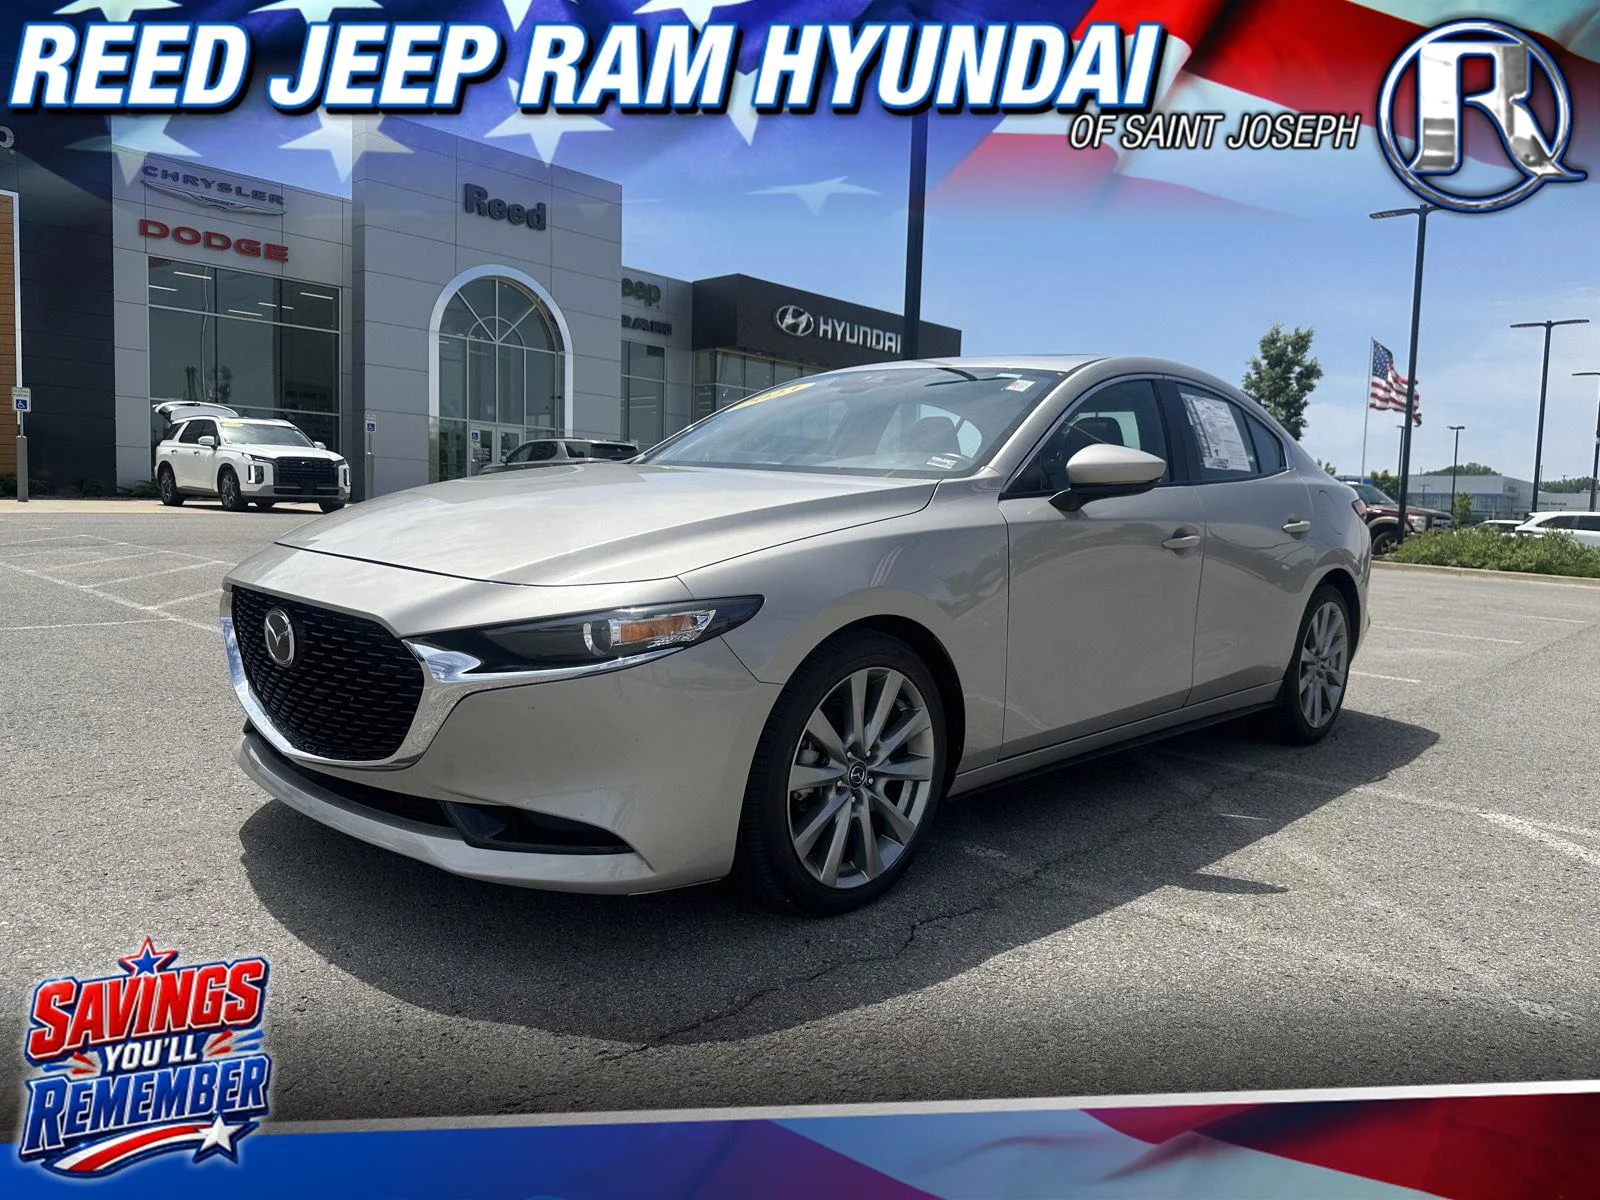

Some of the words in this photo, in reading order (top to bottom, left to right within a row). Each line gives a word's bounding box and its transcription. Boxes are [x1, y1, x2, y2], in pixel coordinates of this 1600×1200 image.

[142, 165, 284, 206] CHRYSLER
[465, 183, 546, 231] Reed
[139, 219, 288, 263] DODGE
[621, 277, 661, 307] eep
[818, 315, 901, 354] HYUNDAI
